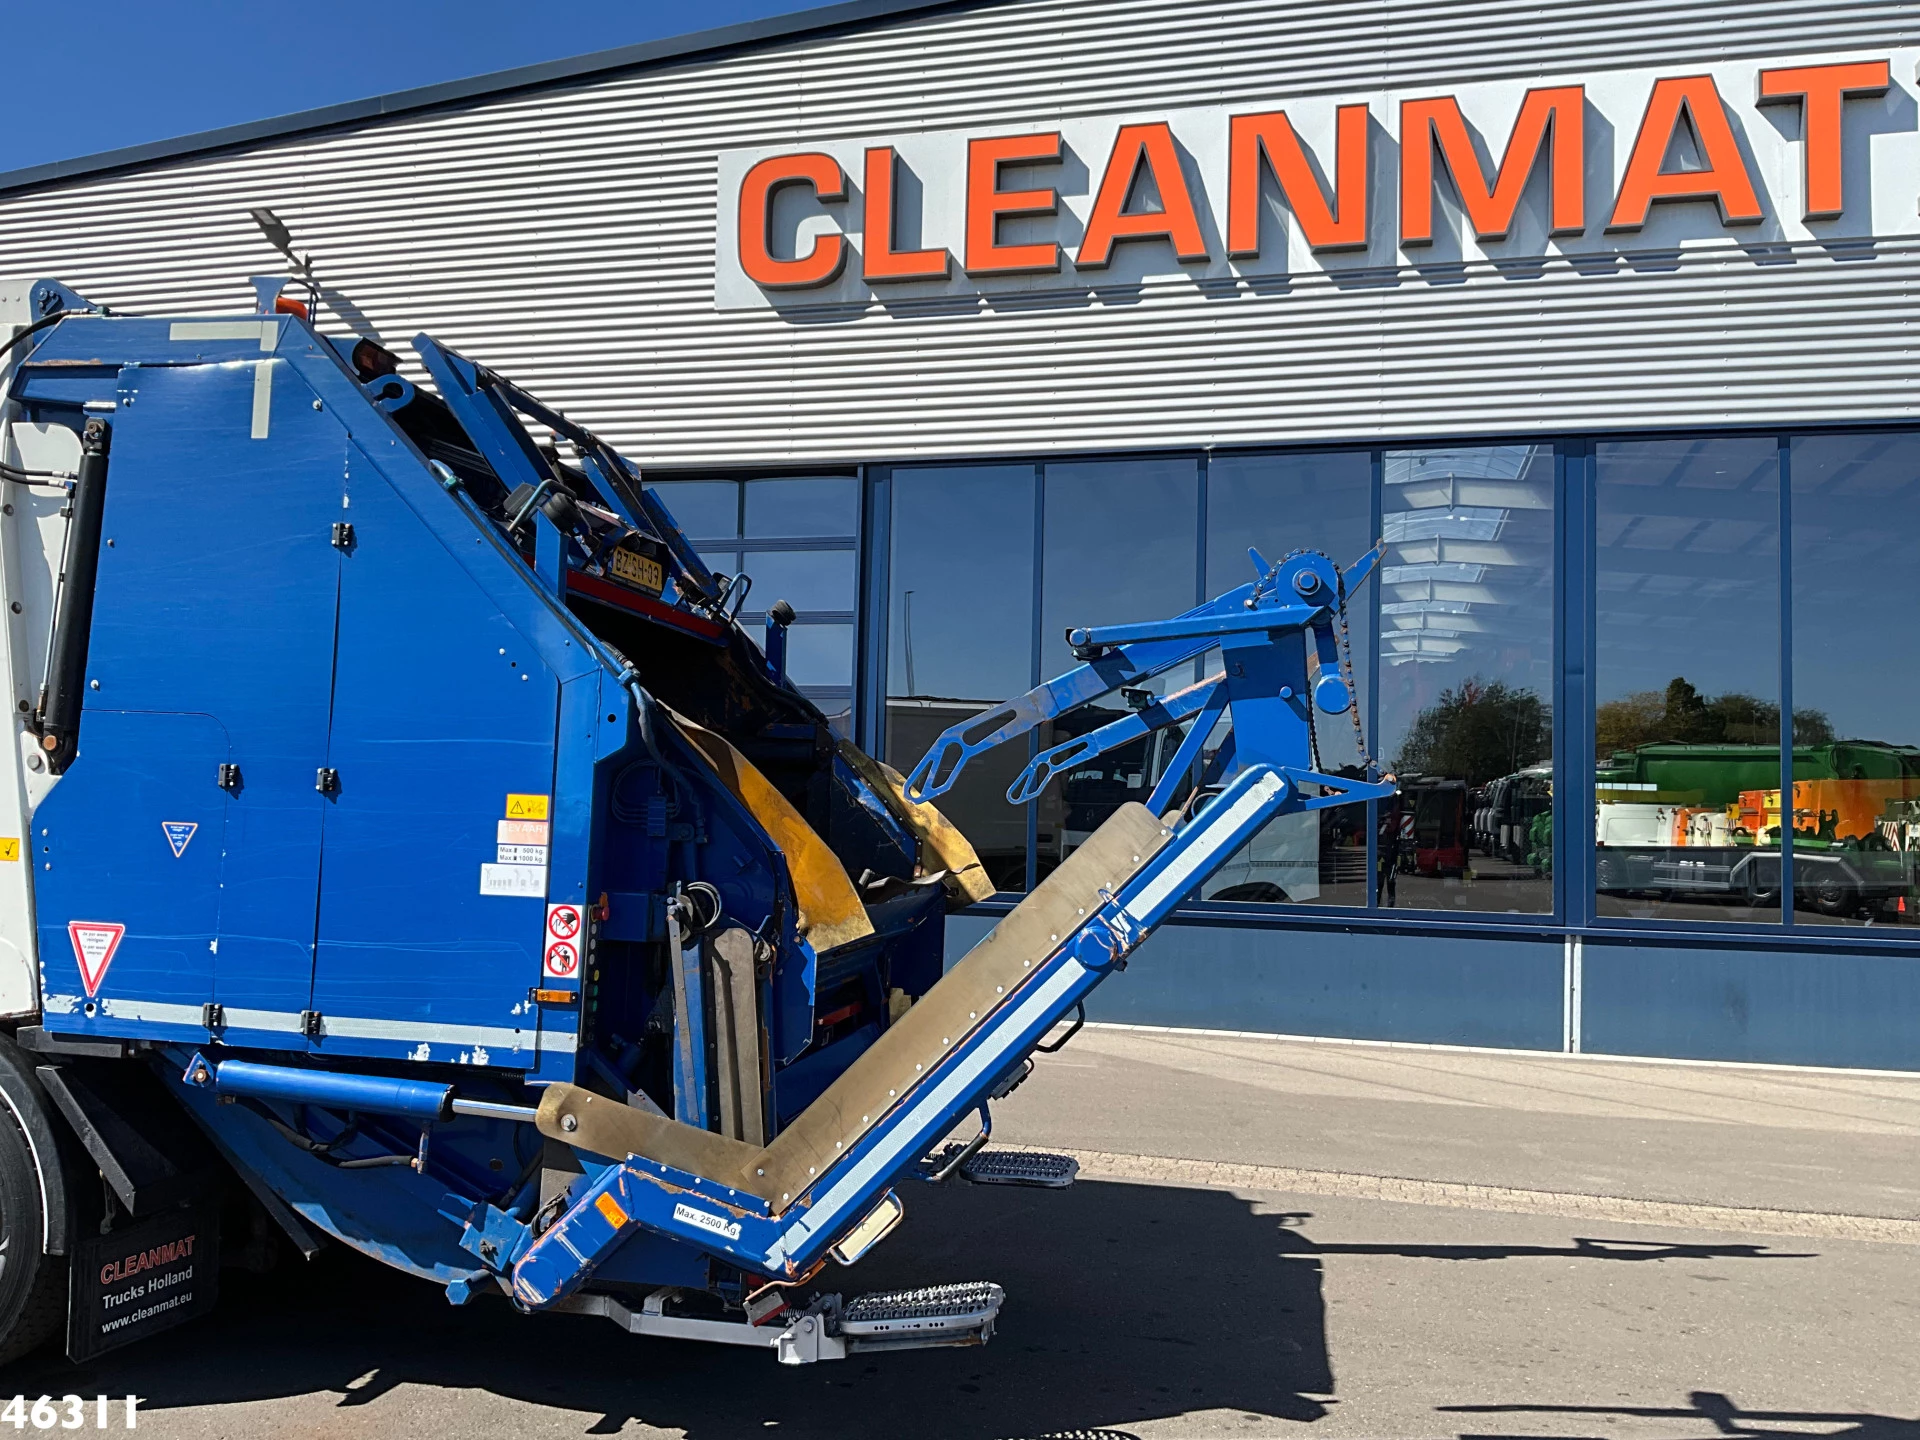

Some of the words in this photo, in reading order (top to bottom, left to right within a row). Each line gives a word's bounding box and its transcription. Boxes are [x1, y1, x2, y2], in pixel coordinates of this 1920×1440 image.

[737, 57, 1891, 291] CLEANMAT
[501, 823, 547, 832] EVAAR!
[700, 1214, 722, 1229] 2500
[100, 1235, 195, 1285] CLEANMAT
[102, 1285, 145, 1309] Trucks
[148, 1265, 193, 1293] Holland
[101, 1292, 193, 1334] www.cleanmat.eu
